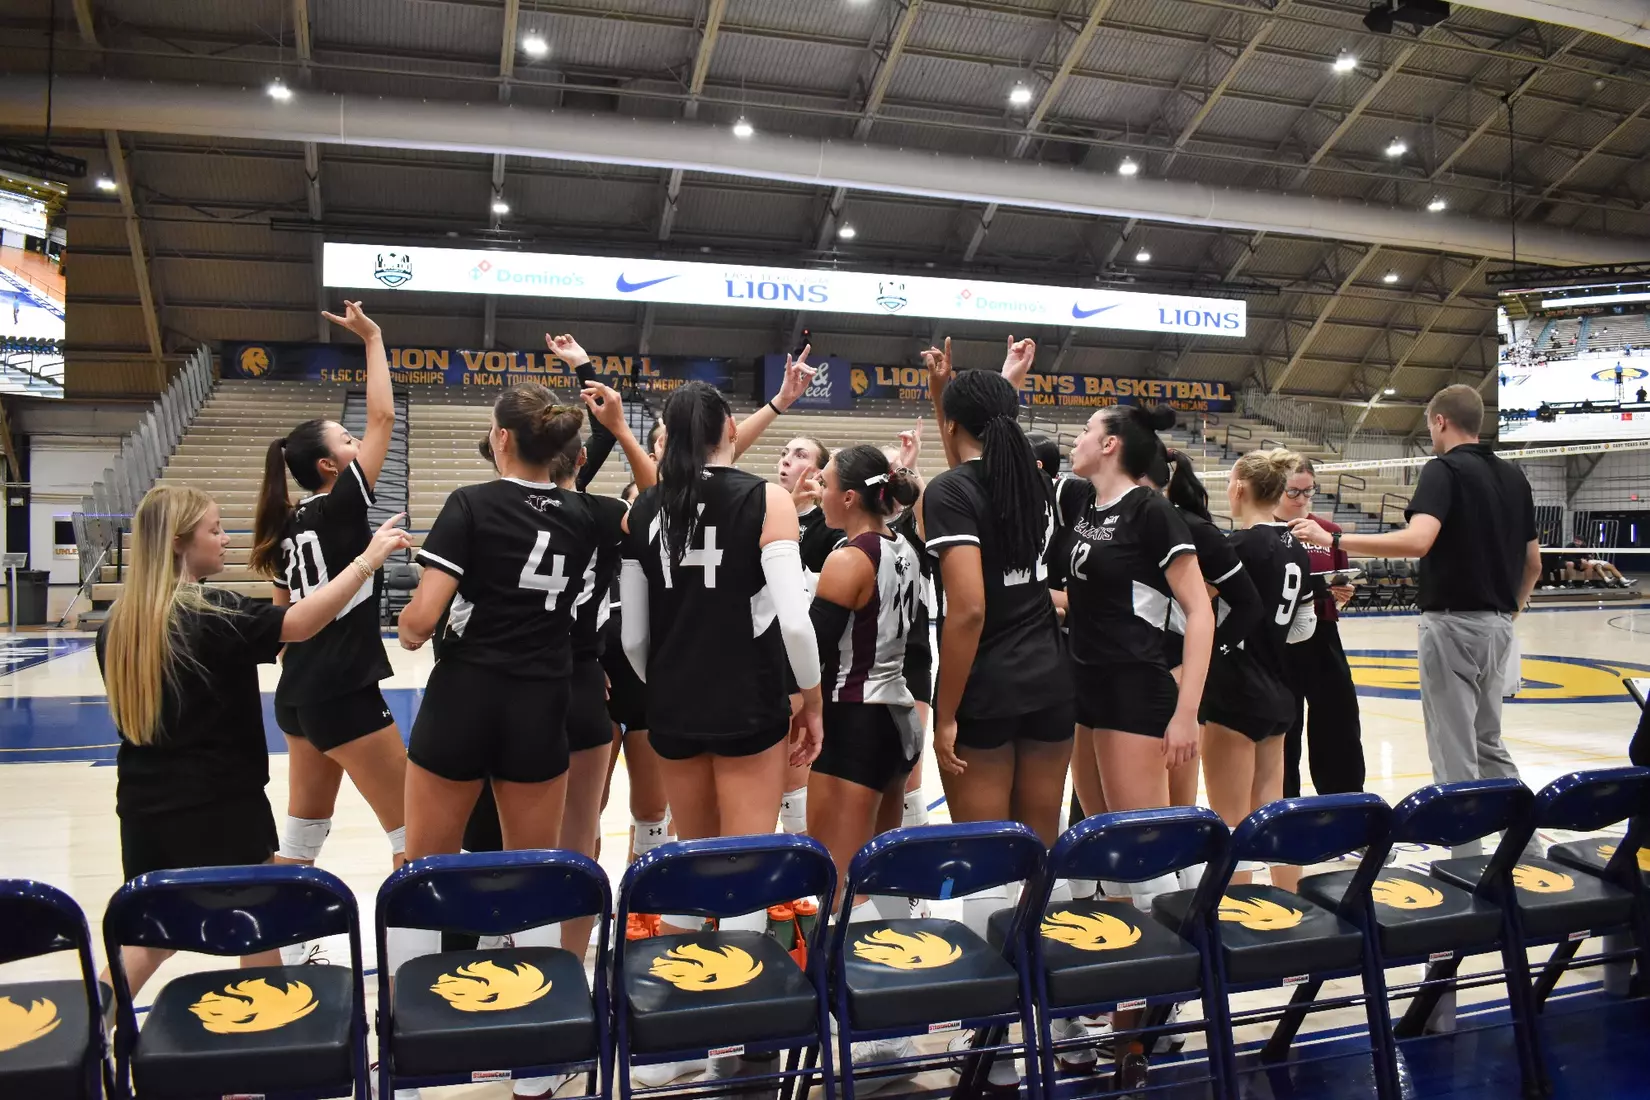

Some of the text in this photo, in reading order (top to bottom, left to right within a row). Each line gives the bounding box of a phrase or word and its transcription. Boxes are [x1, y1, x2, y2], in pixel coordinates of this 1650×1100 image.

[497, 269, 585, 286] Domino's
[725, 279, 829, 303] LIONS
[1158, 308, 1240, 329] LIONS
[387, 349, 449, 370] ION
[320, 368, 444, 384] 5 LSC CHPIONSHIPS
[463, 372, 470, 385] 6
[473, 373, 502, 386] NCAA
[805, 382, 833, 398] eed
[1032, 393, 1055, 405] NCAA
[1083, 376, 1231, 401] BASKETBALL
[649, 503, 724, 588] 14
[280, 530, 329, 604] 20
[518, 530, 569, 612] 4
[1070, 540, 1092, 581] 12
[1274, 562, 1302, 626] 9
[893, 580, 914, 639] 11
